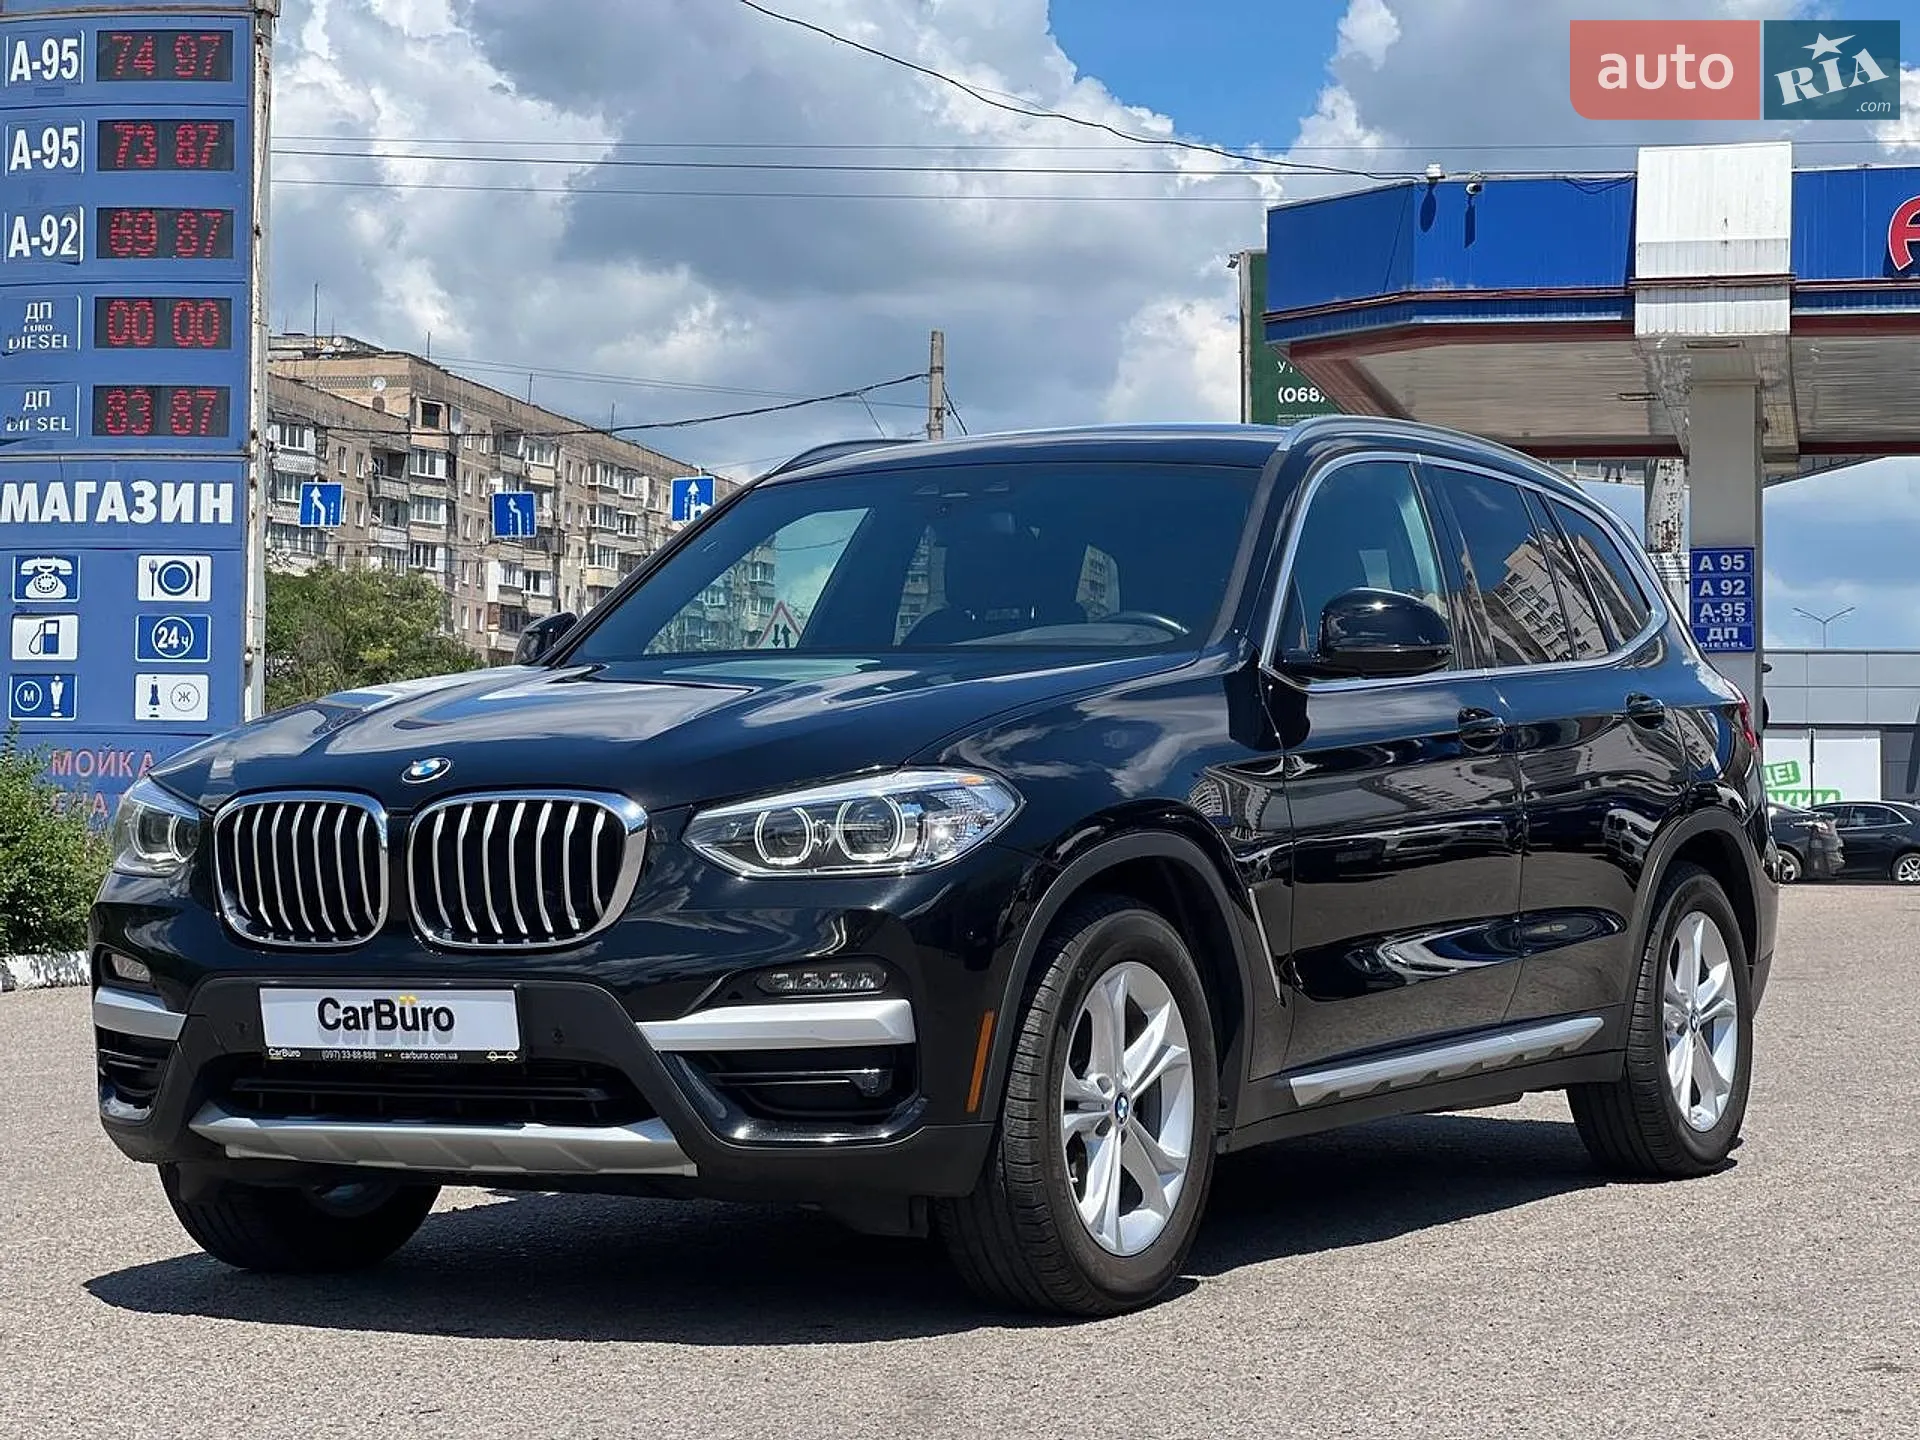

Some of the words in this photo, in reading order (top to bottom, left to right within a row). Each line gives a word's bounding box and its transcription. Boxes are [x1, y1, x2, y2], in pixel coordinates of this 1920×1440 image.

[10, 38, 79, 82] А-95
[111, 35, 156, 76] 74
[9, 127, 80, 171] А-95
[113, 124, 157, 168] 73
[175, 124, 219, 168] 87
[8, 214, 78, 259] А-92
[110, 211, 157, 257] 69
[175, 211, 223, 257] 87
[25, 302, 52, 323] ДП
[106, 300, 155, 347] 00
[172, 300, 220, 347] 00
[23, 390, 50, 411] ДП
[105, 389, 152, 435] 83
[170, 389, 217, 435] 87
[0, 480, 234, 524] МАГАЗИН
[1720, 554, 1745, 571] 95
[1720, 579, 1745, 596] 92
[1699, 602, 1746, 617] А-95
[1706, 627, 1738, 641] ДП
[52, 744, 154, 778] МОЙКА
[317, 994, 455, 1032] CarBüro
